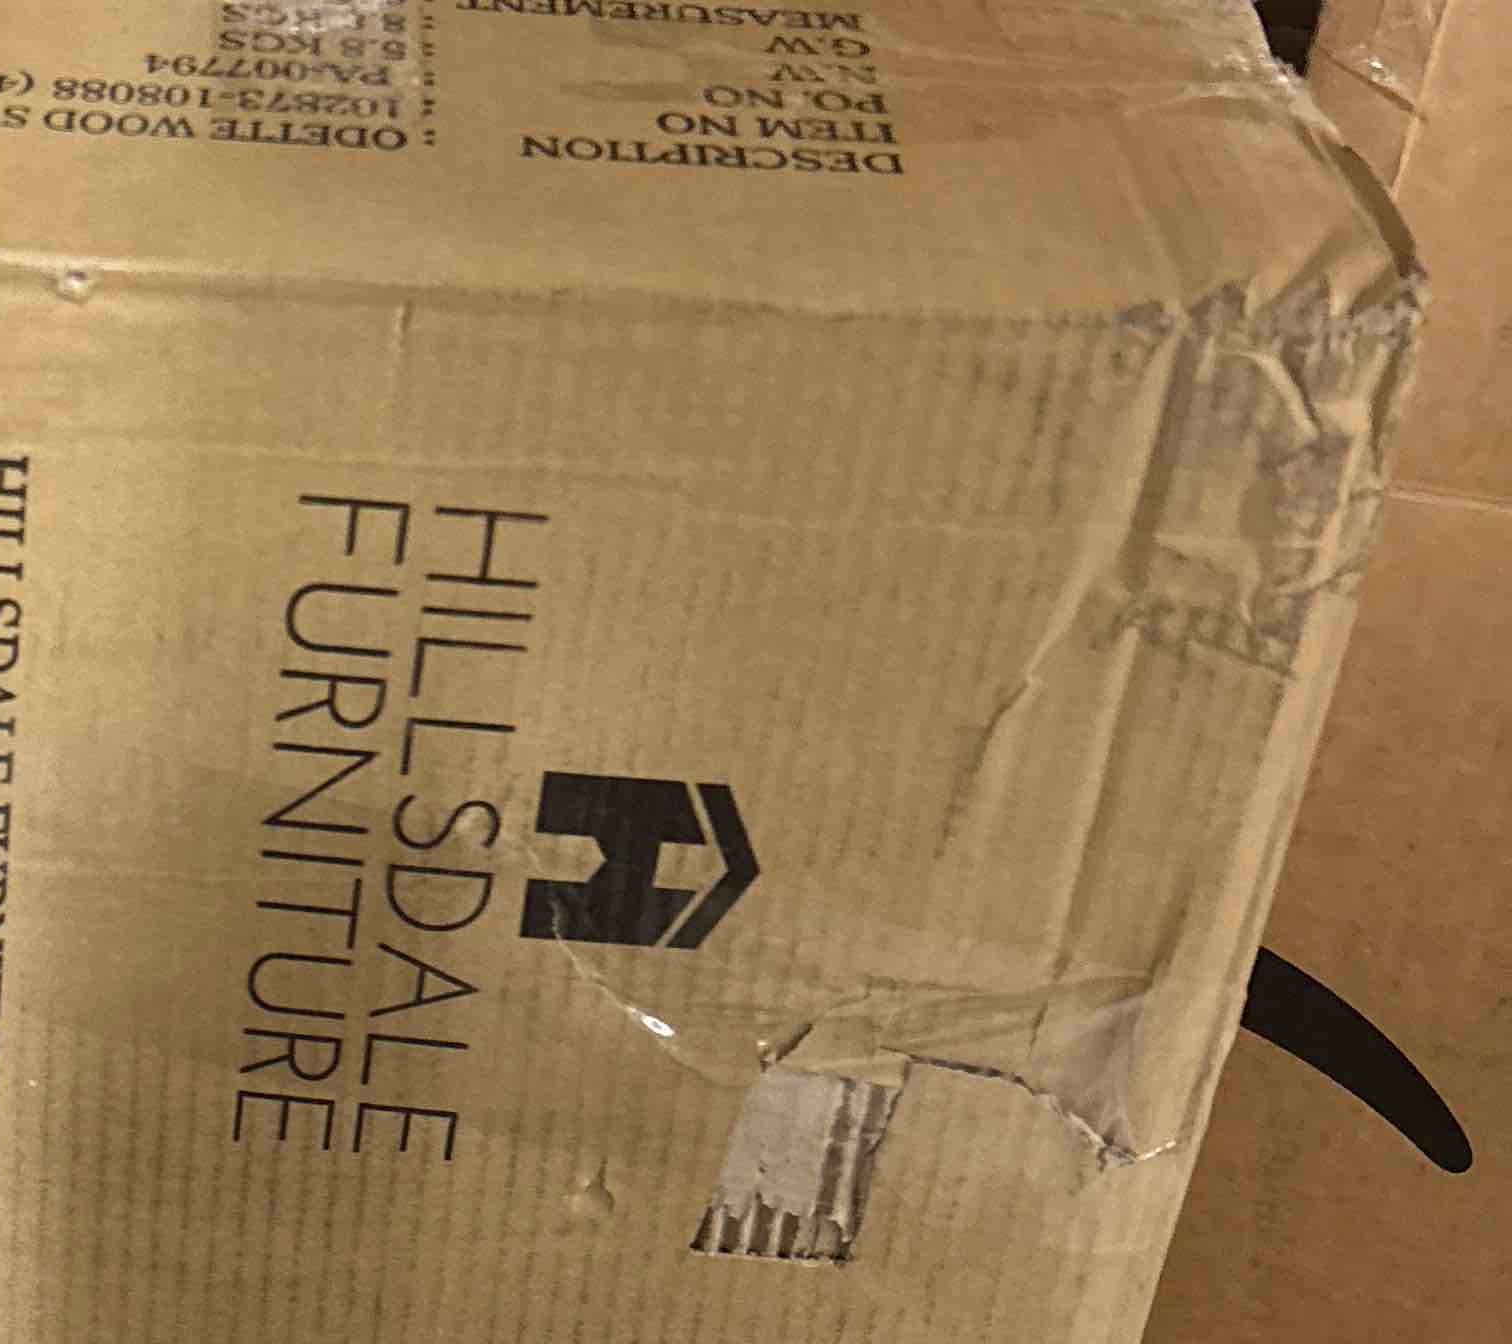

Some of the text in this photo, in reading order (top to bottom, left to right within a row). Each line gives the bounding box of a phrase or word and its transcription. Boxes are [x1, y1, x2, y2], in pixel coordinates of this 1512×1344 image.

[216, 29, 323, 56] KGS
[763, 36, 870, 59] G.W
[53, 76, 402, 119] 102873-108088
[142, 52, 888, 115] PO. NO PA-007794
[42, 108, 194, 140] WOOD
[209, 117, 407, 152] ODETTE
[655, 112, 738, 138] NO
[756, 116, 897, 144] ITEM
[520, 135, 903, 175] DESCRIPTION
[233, 495, 410, 1151] FURNITURE
[352, 506, 549, 1160] HILLSDALE
